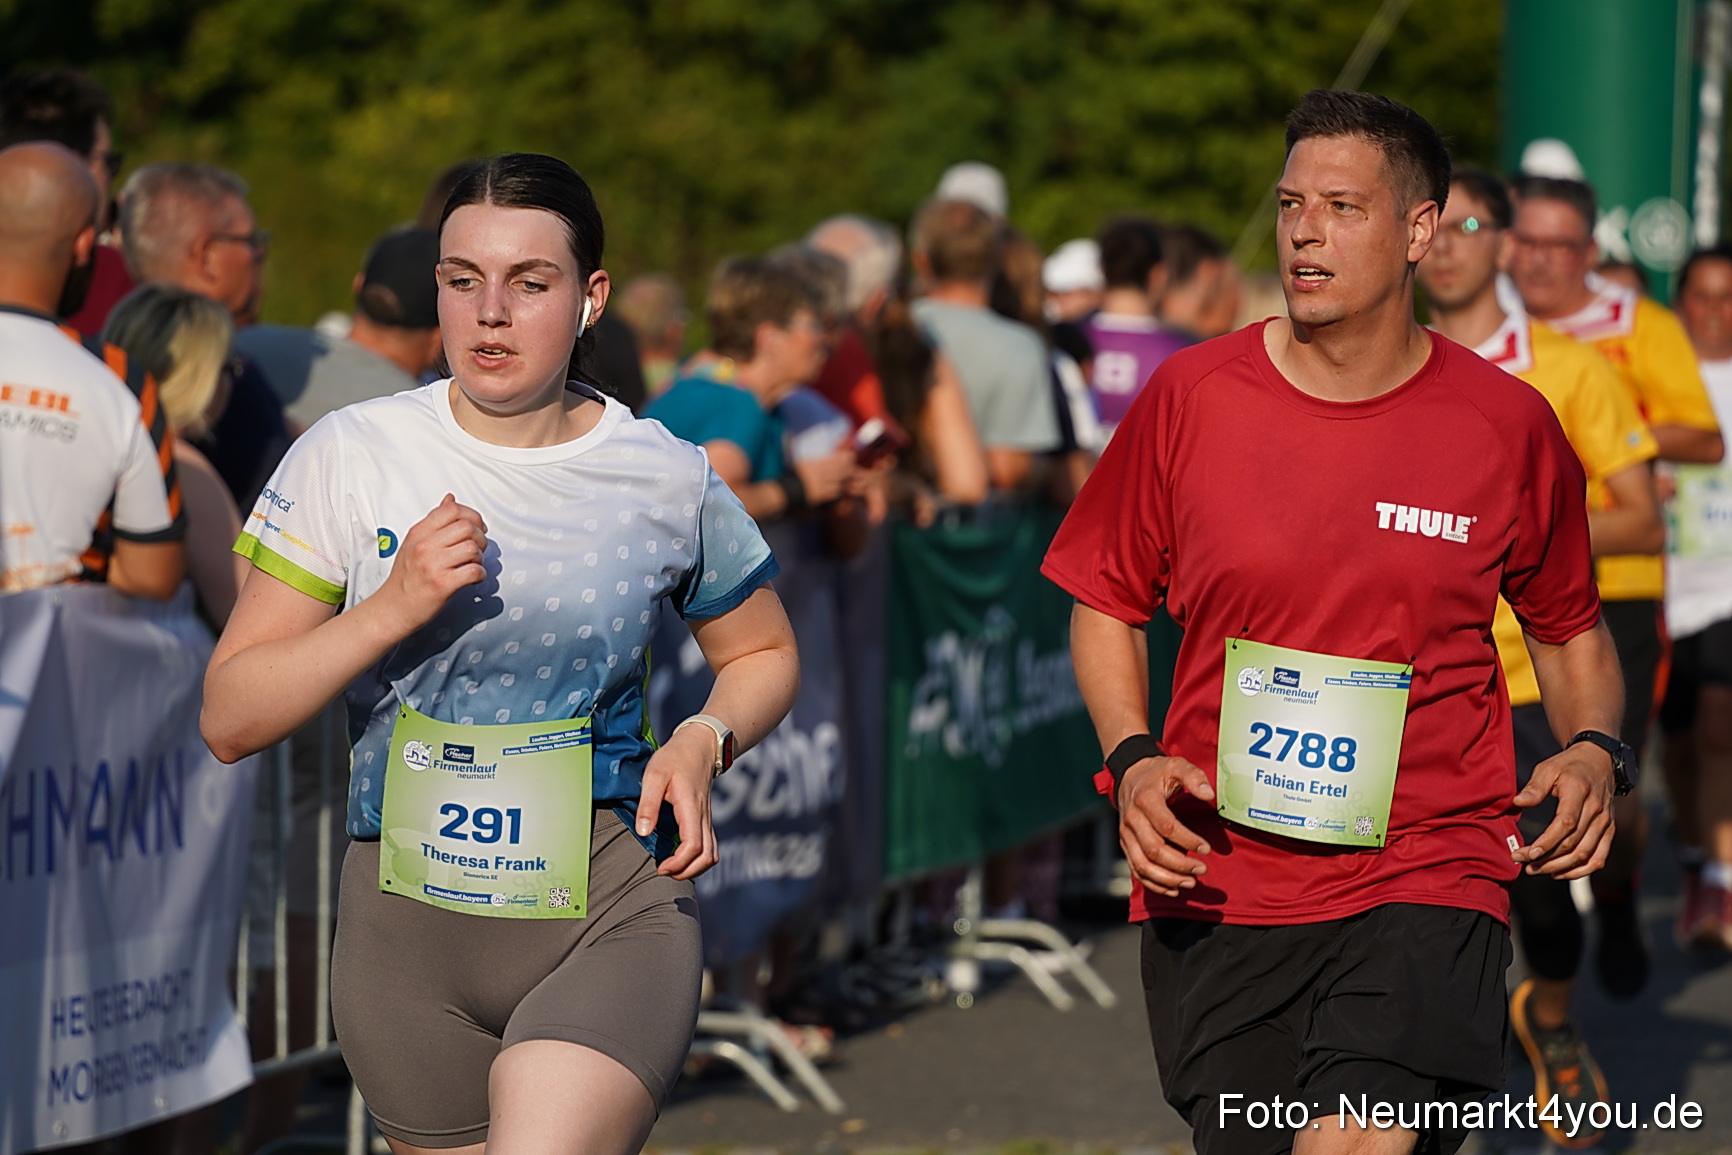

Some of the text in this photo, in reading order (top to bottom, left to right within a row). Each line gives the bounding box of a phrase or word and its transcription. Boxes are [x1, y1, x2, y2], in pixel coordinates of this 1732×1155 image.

[1445, 531, 1465, 540] SWEDEN
[1264, 684, 1319, 699] Firmenlauf
[1283, 696, 1317, 705] neumarkt
[1248, 721, 1357, 773] 2788
[433, 759, 498, 773] Firmenlauf
[457, 772, 496, 780] neumarkt
[1255, 768, 1348, 798] Fabian Ertel
[439, 803, 522, 845] 291
[1250, 809, 1303, 825] firmenlauf.bayern
[421, 842, 547, 871] Theresa Frank
[463, 871, 490, 880] Bionorica
[426, 886, 489, 903] firmenlauf.bayern
